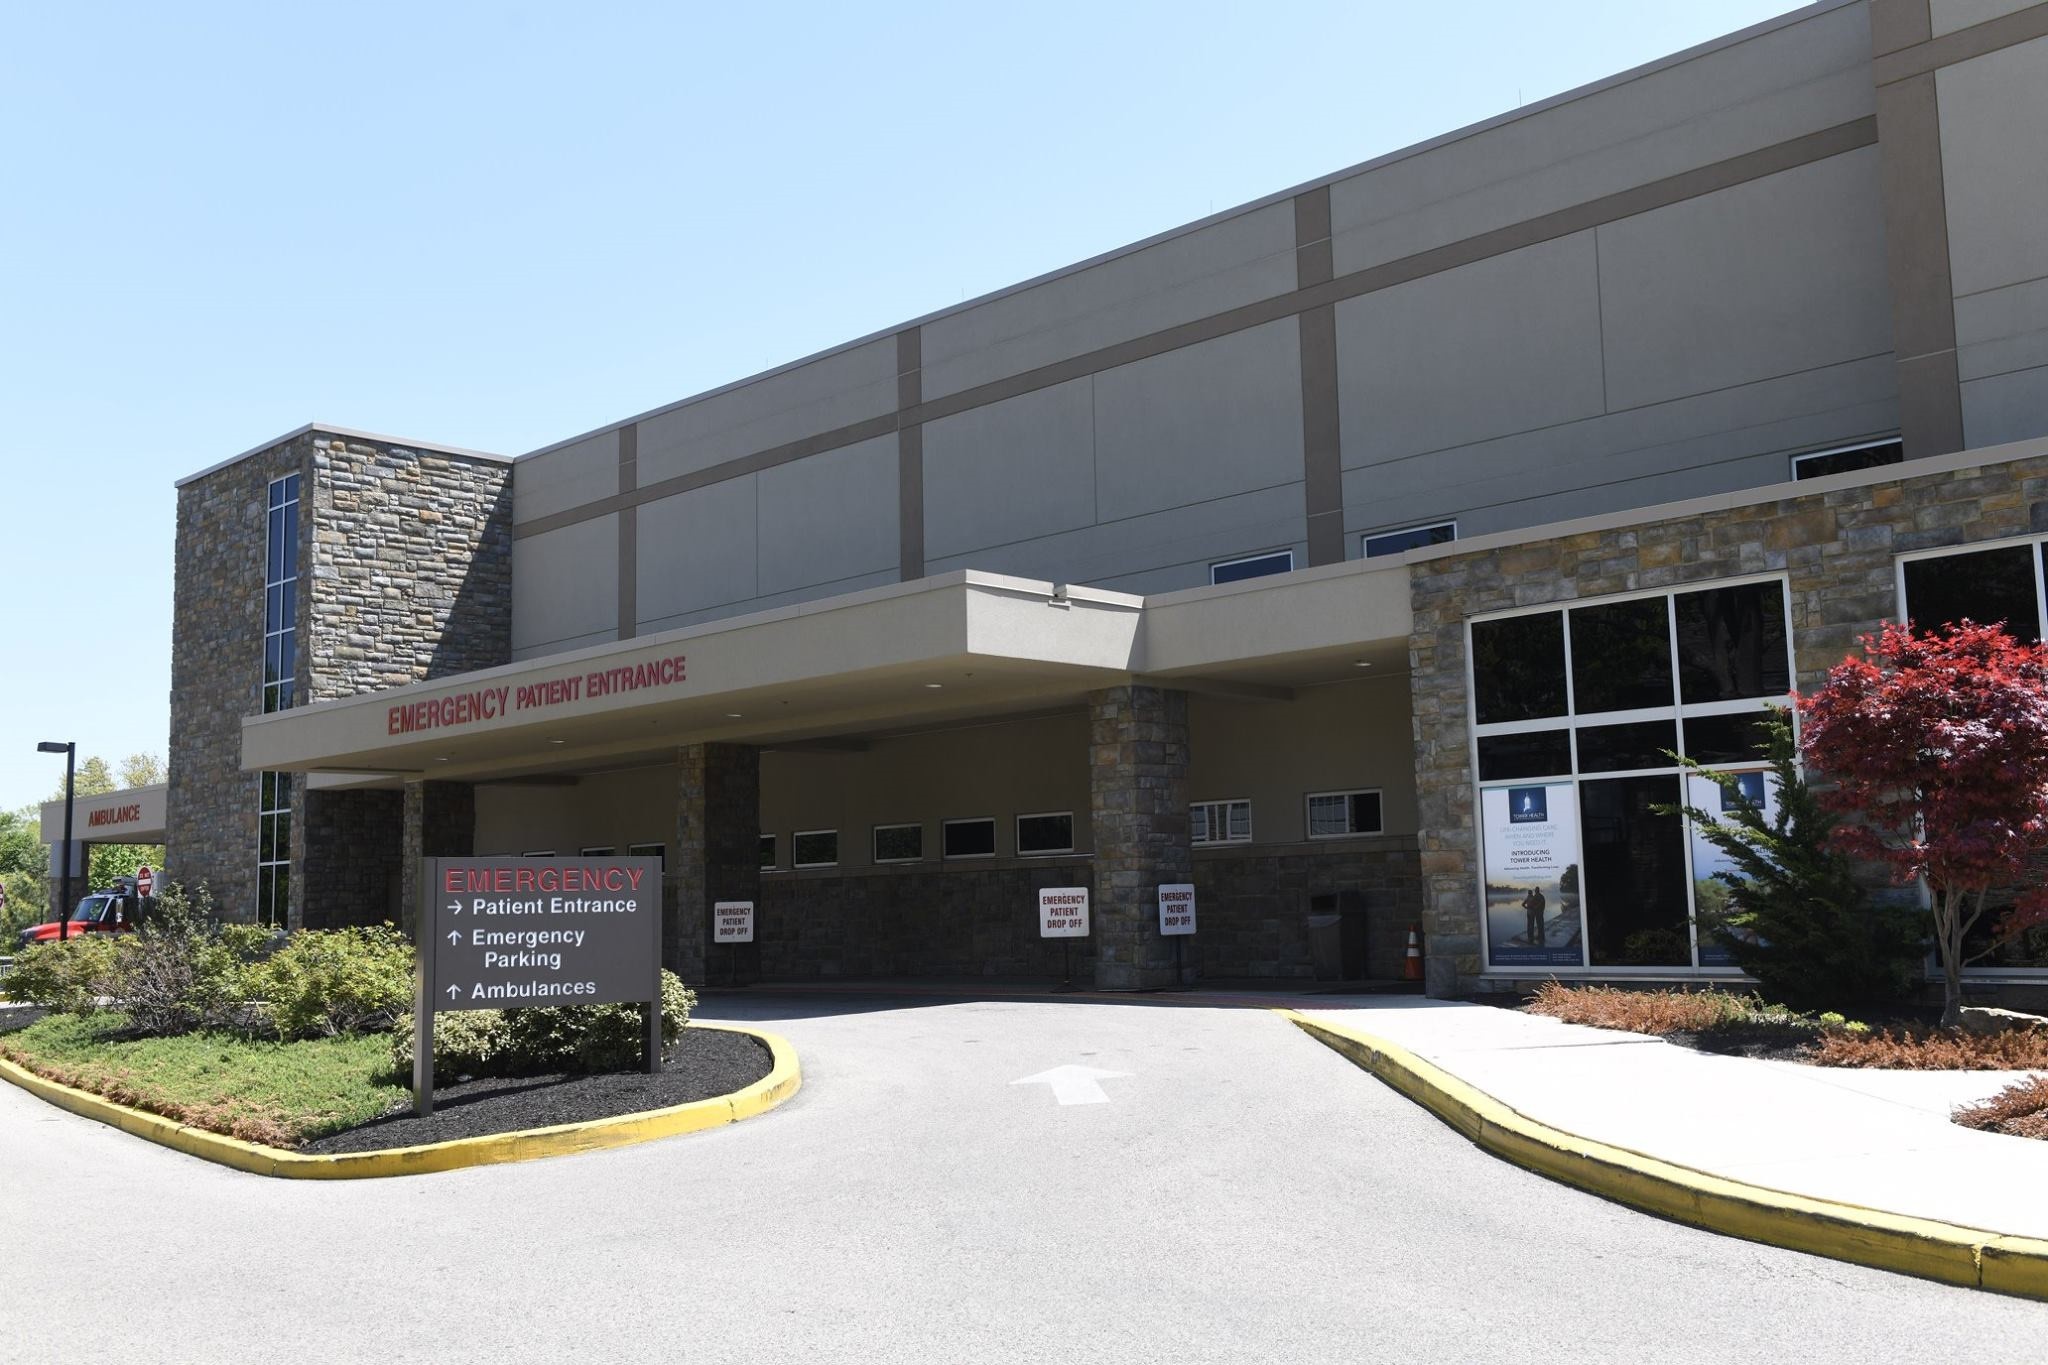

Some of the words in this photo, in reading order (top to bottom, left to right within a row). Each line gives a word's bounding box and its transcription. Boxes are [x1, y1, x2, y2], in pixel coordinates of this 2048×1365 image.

[388, 685, 510, 736] EMERGENCY
[516, 676, 582, 711] PATIENT
[586, 656, 687, 698] ENTRANCE
[88, 804, 140, 828] AMBULANCE
[445, 866, 645, 893] EMERGENCY
[1042, 895, 1085, 905] EMERGENCY
[1161, 892, 1193, 902] EMERGENCY
[473, 898, 543, 915] Patient
[550, 897, 637, 914] Entrance
[1167, 904, 1188, 914] PATIENT
[717, 908, 751, 916] EMERGENCY
[1050, 907, 1078, 916] PATIENT
[722, 918, 745, 926] PATIENT
[1047, 919, 1067, 929] DROP
[1069, 919, 1082, 928] OFF
[1165, 917, 1179, 926] DROP
[1181, 916, 1191, 925] OFF
[720, 928, 735, 936] DROP
[737, 927, 748, 935] OFF
[472, 929, 585, 949] Emergency
[485, 951, 562, 970] Parking
[471, 980, 596, 999] Ambulances
